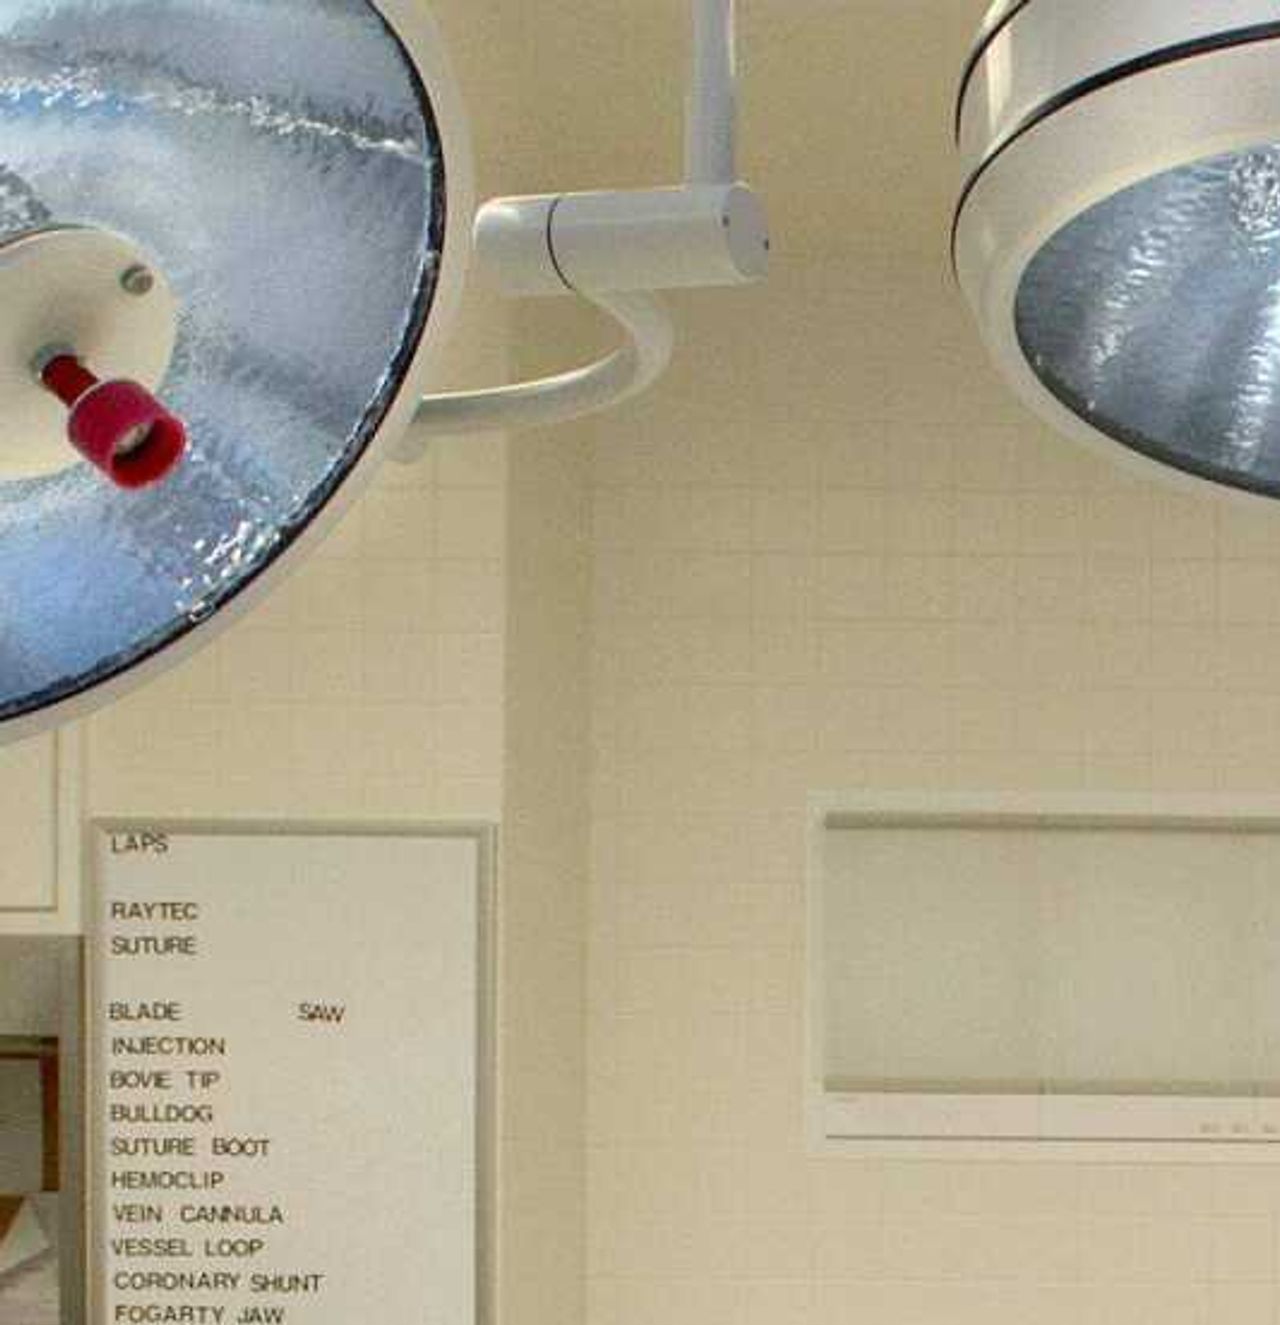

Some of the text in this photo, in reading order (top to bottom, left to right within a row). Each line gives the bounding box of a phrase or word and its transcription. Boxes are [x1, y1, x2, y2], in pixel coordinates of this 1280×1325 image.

[110, 833, 169, 854] LAPS
[110, 901, 198, 922] RAYTEC
[110, 935, 197, 956] SUTURE
[108, 1001, 181, 1022] BLADE
[297, 1002, 346, 1024] SAW
[111, 1036, 226, 1056] INJECTION
[109, 1070, 221, 1091] BOVIE TIP
[109, 1103, 214, 1124] BULLDOG
[110, 1137, 271, 1157] SUTURE BOOT
[110, 1170, 226, 1190] HEMOCLIP
[113, 1204, 285, 1225] VEIN CANNULA
[111, 1238, 266, 1258] VESSEL LOOP
[113, 1271, 326, 1293] CORONARY SHUNT
[114, 1304, 286, 1325] FOGARTY JAW
